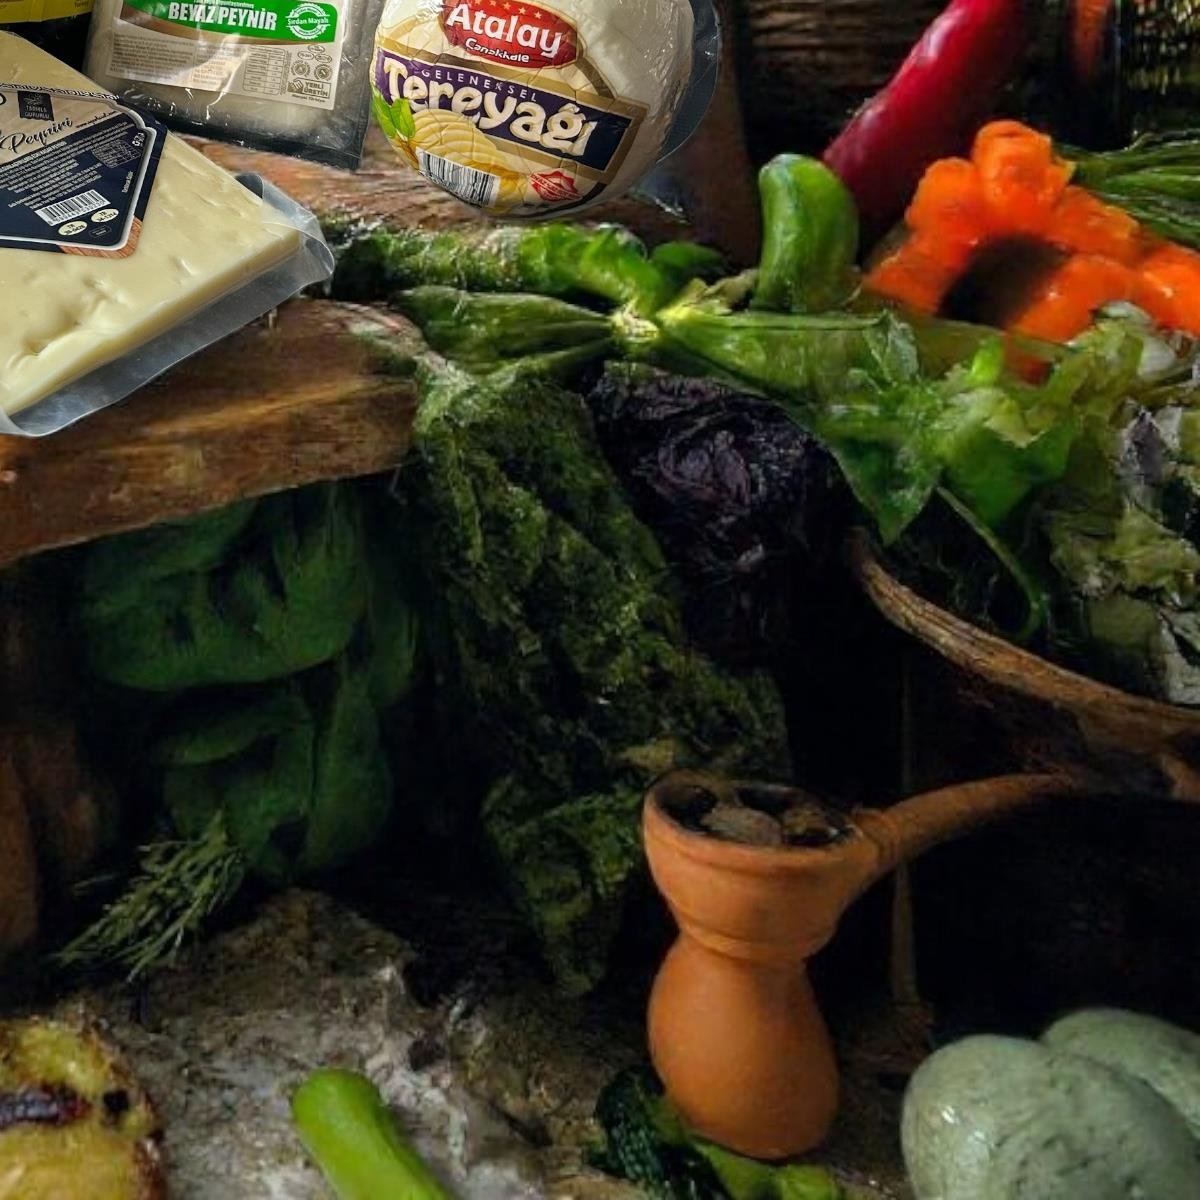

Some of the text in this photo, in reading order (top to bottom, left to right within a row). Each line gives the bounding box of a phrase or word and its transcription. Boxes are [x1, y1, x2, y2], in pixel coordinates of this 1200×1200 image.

[168, 2, 215, 24] BEYAZ
[217, 7, 278, 31] PEYNİR
[446, 3, 563, 59] Atalay
[384, 57, 598, 156] Tereyağı
